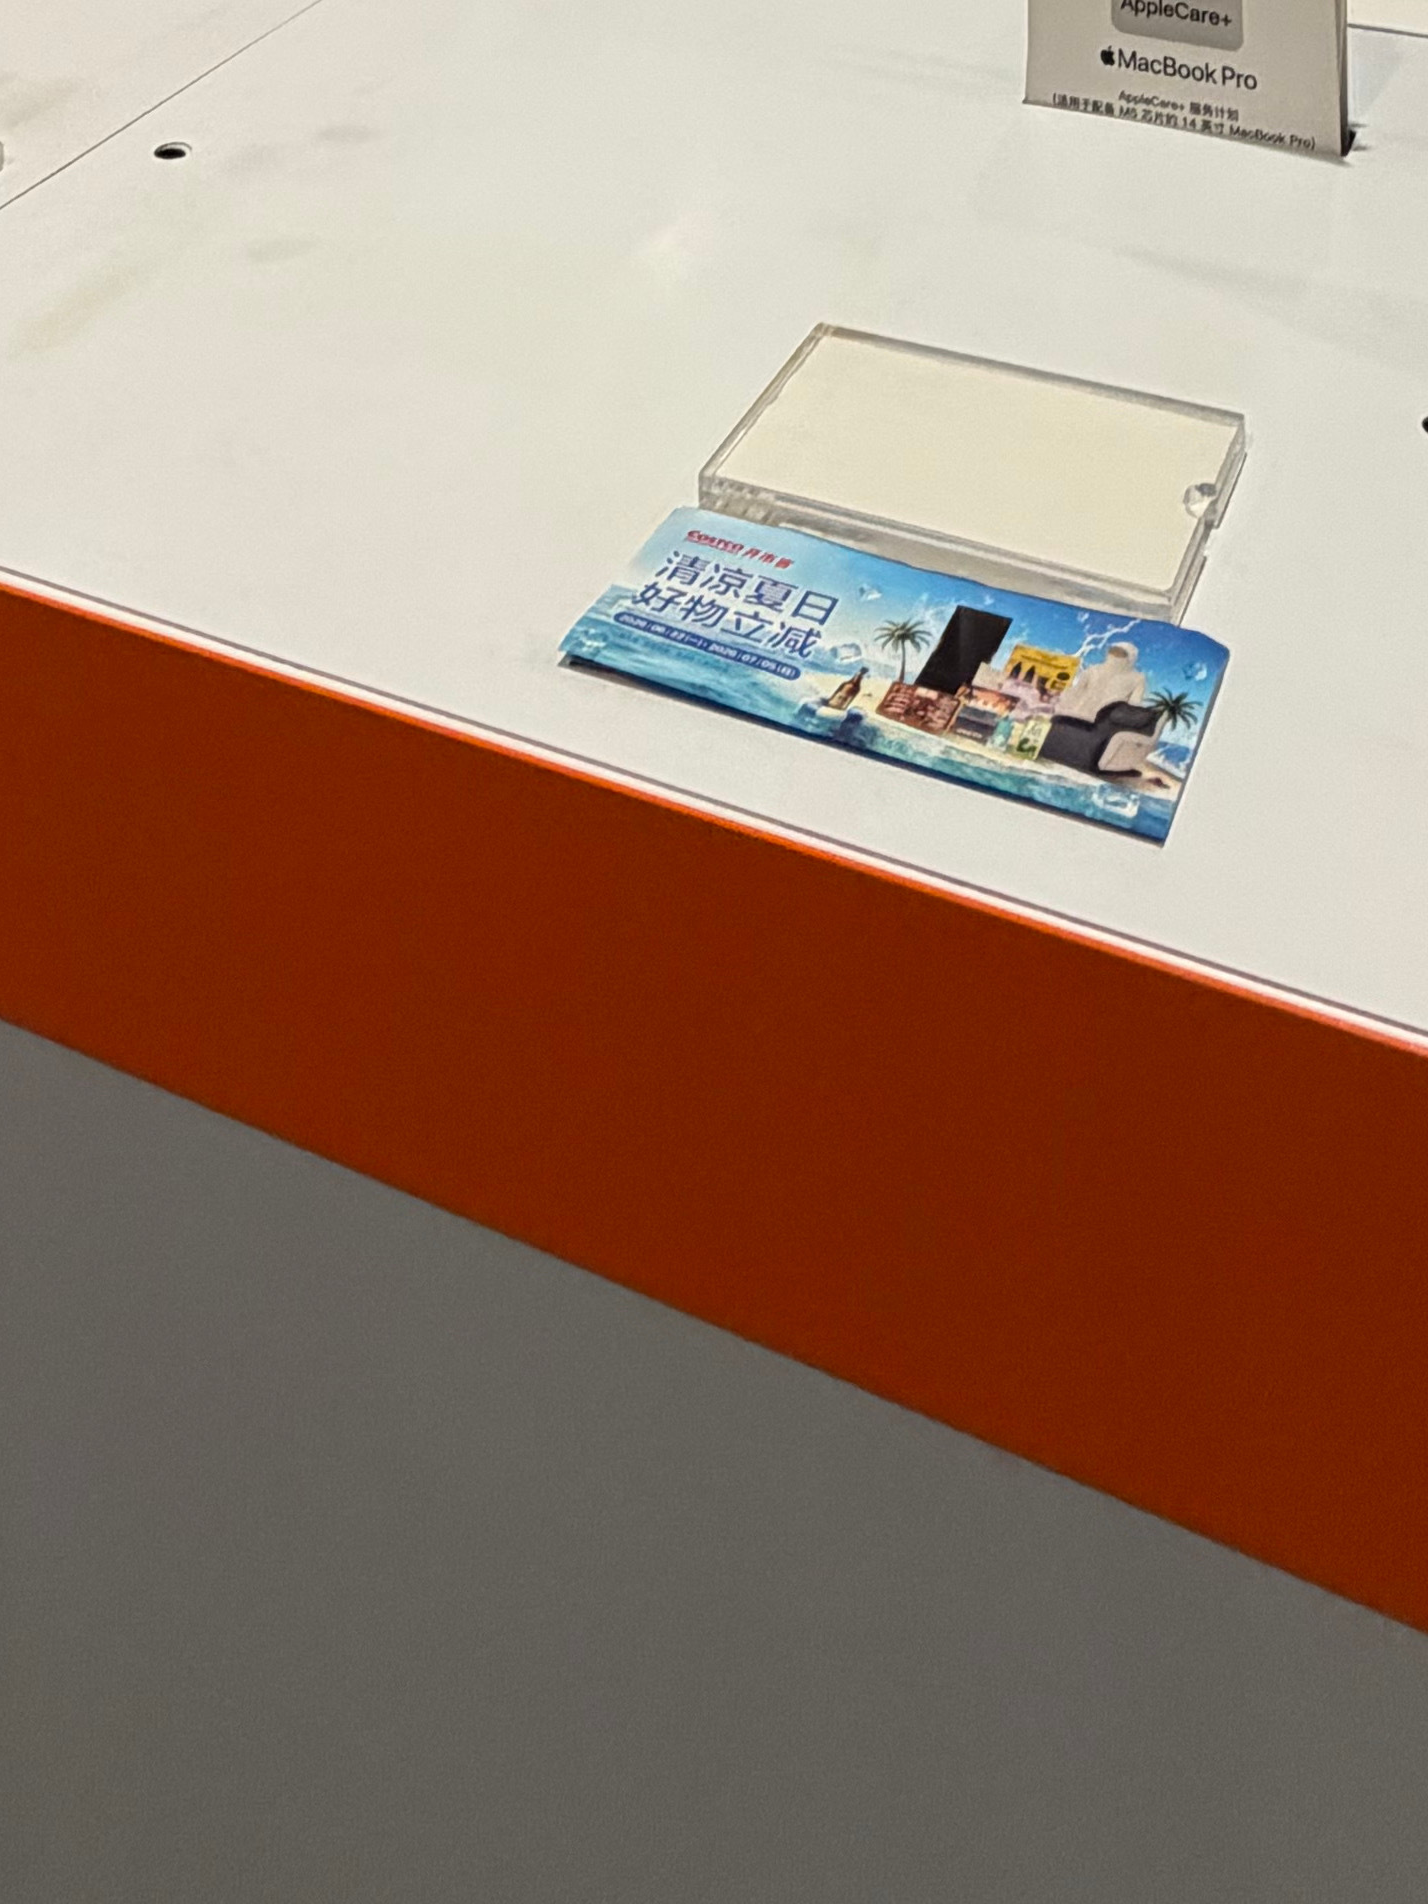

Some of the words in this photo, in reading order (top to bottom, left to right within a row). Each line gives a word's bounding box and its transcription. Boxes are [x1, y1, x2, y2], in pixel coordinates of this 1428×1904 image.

[1117, 48, 1218, 86] MacBook
[1221, 56, 1258, 91] Pro
[1118, 90, 1185, 111] AppleCare+
[1189, 101, 1239, 122] 服务计划
[1181, 116, 1198, 130] 14
[1200, 121, 1225, 136] 英寸
[1228, 126, 1287, 145] MacBook
[654, 550, 840, 626] 清凉夏日
[632, 581, 823, 660] 好物立减
